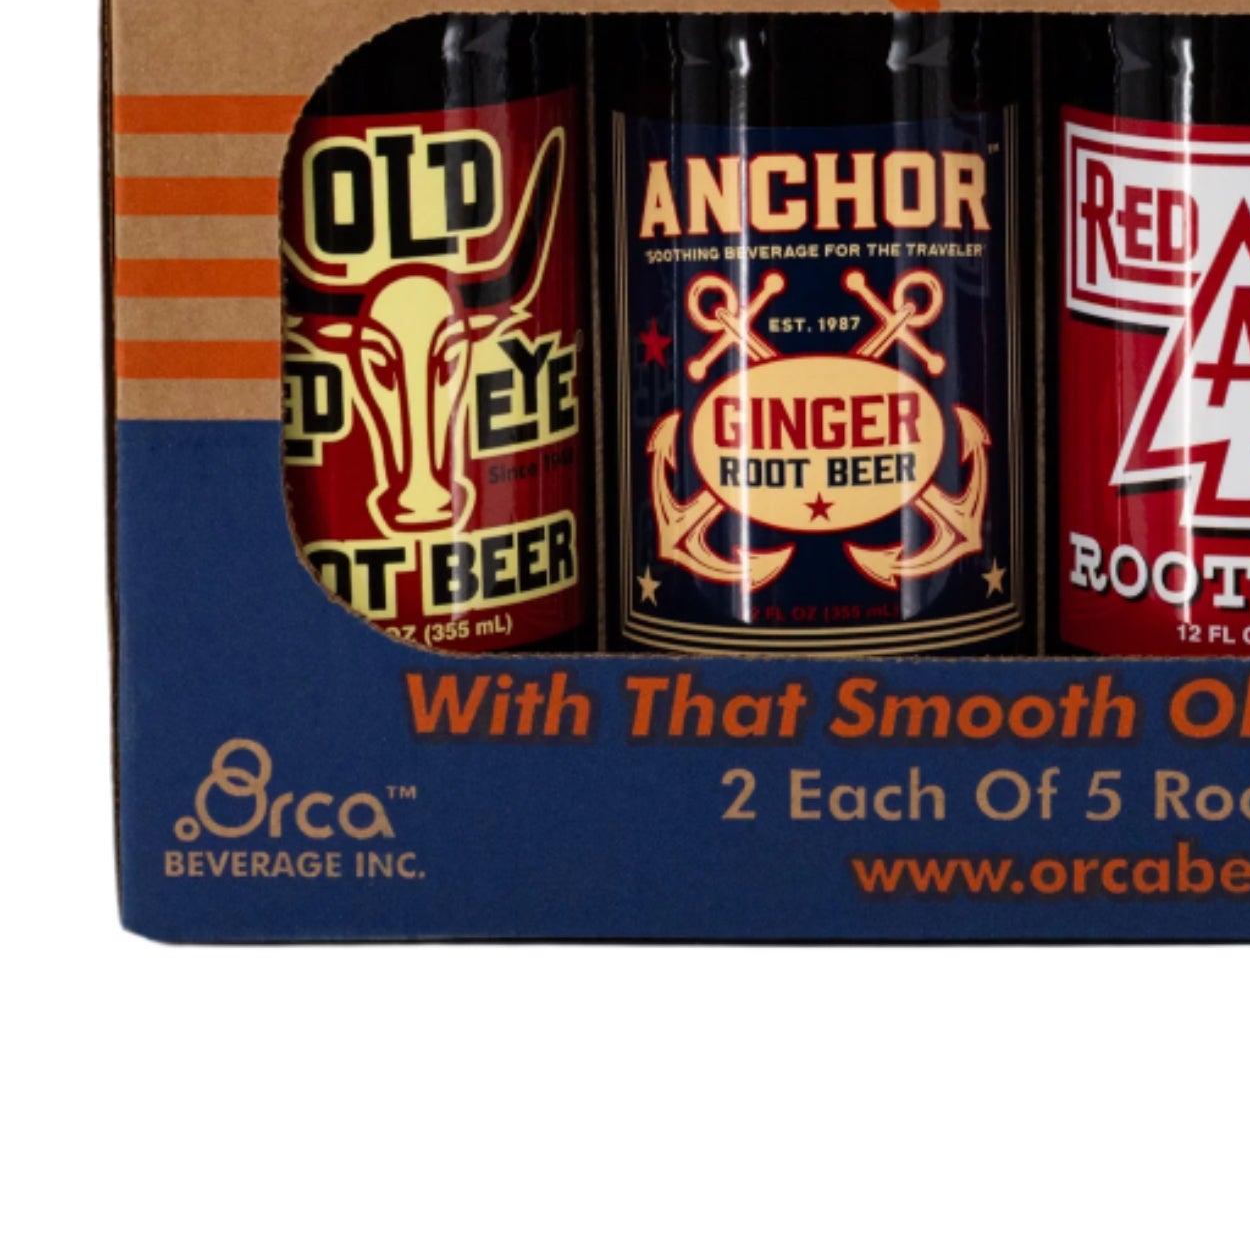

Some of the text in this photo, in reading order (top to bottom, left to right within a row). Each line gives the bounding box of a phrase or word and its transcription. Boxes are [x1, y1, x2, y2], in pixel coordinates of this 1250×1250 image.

[312, 133, 496, 259] OLD
[1081, 156, 1199, 286] RED
[724, 244, 819, 261] BEVERAGE
[824, 243, 861, 258] FOR
[866, 243, 901, 258] THE
[768, 316, 861, 332] EST. 1987
[476, 338, 576, 452] EYE
[713, 391, 922, 451] GINGER
[719, 453, 917, 489] ROOT BEER
[431, 518, 574, 606] BEER
[424, 619, 470, 648] (355
[475, 612, 513, 636] mL)
[1176, 623, 1201, 643] 12
[1208, 625, 1236, 644] FL
[404, 673, 591, 737] With
[624, 673, 807, 737] That
[829, 675, 1136, 739] Smooth
[720, 768, 757, 821] 2
[790, 767, 946, 821] Each
[975, 768, 1061, 821] Of
[1085, 769, 1122, 821] 5
[164, 851, 426, 879] BEVERAGE INC.
